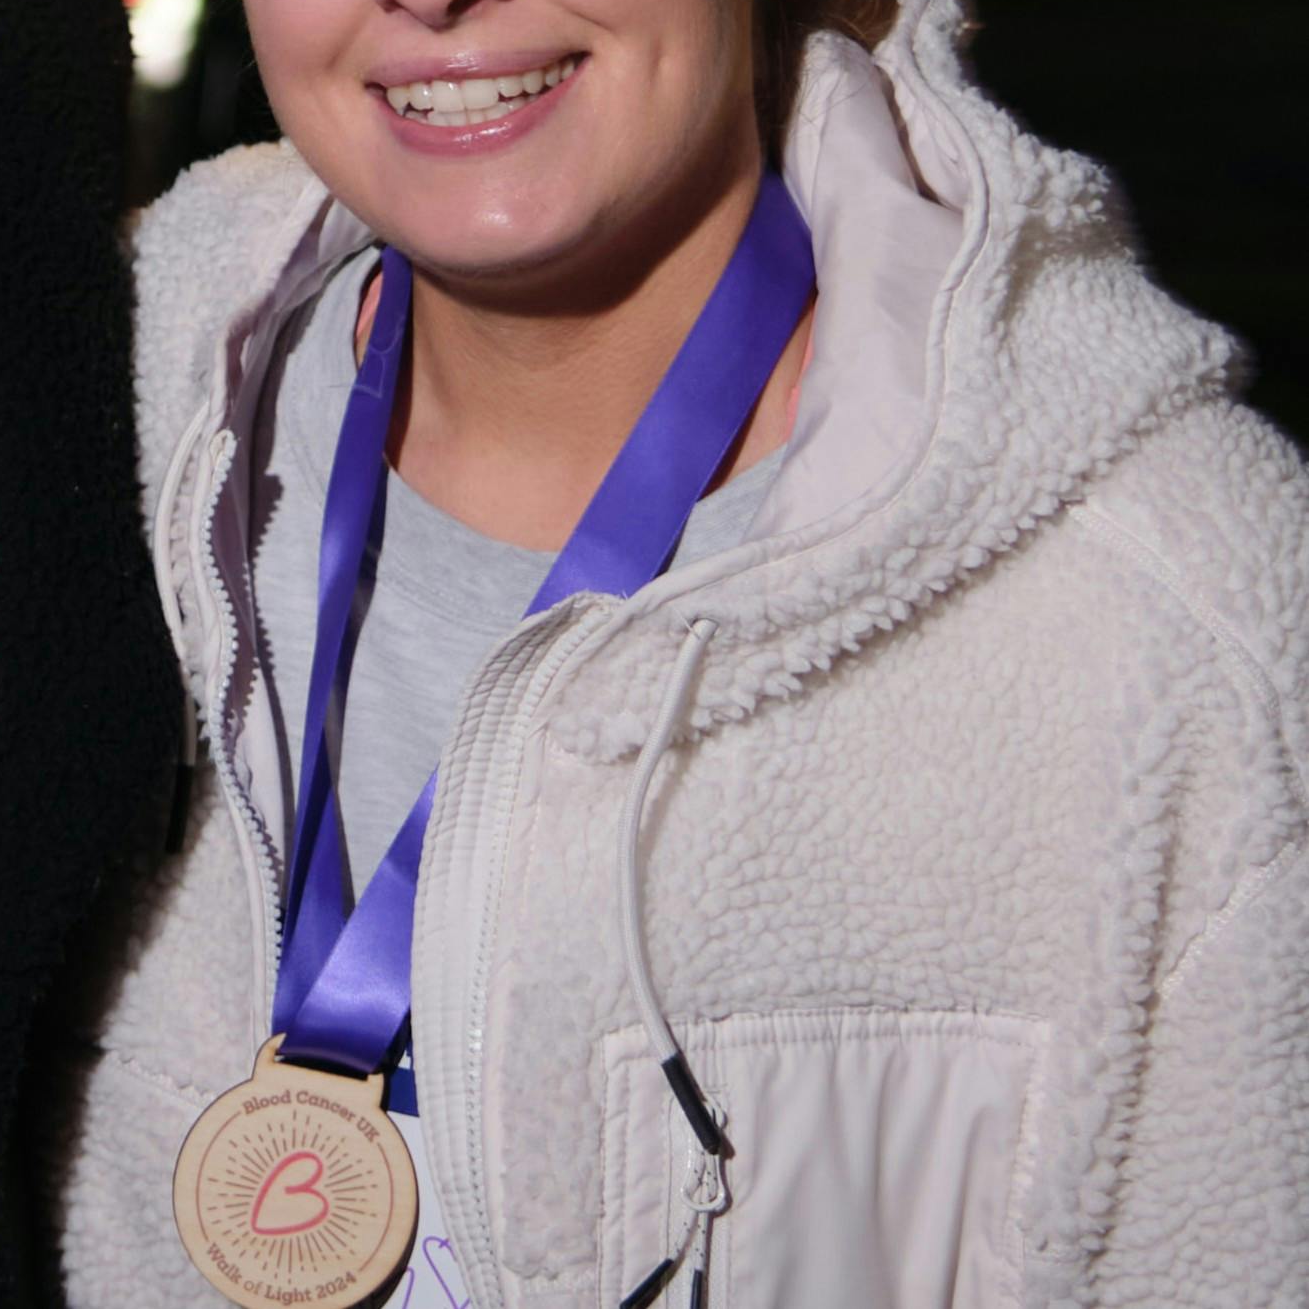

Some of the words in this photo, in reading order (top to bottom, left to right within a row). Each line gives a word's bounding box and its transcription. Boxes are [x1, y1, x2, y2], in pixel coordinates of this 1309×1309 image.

[243, 1090, 292, 1116] Blood
[296, 1091, 354, 1122] Cancer
[355, 1116, 380, 1143] UK
[206, 1243, 243, 1287] Walk
[243, 1279, 261, 1296] of
[264, 1286, 312, 1305] Light
[315, 1271, 357, 1296] 2024
